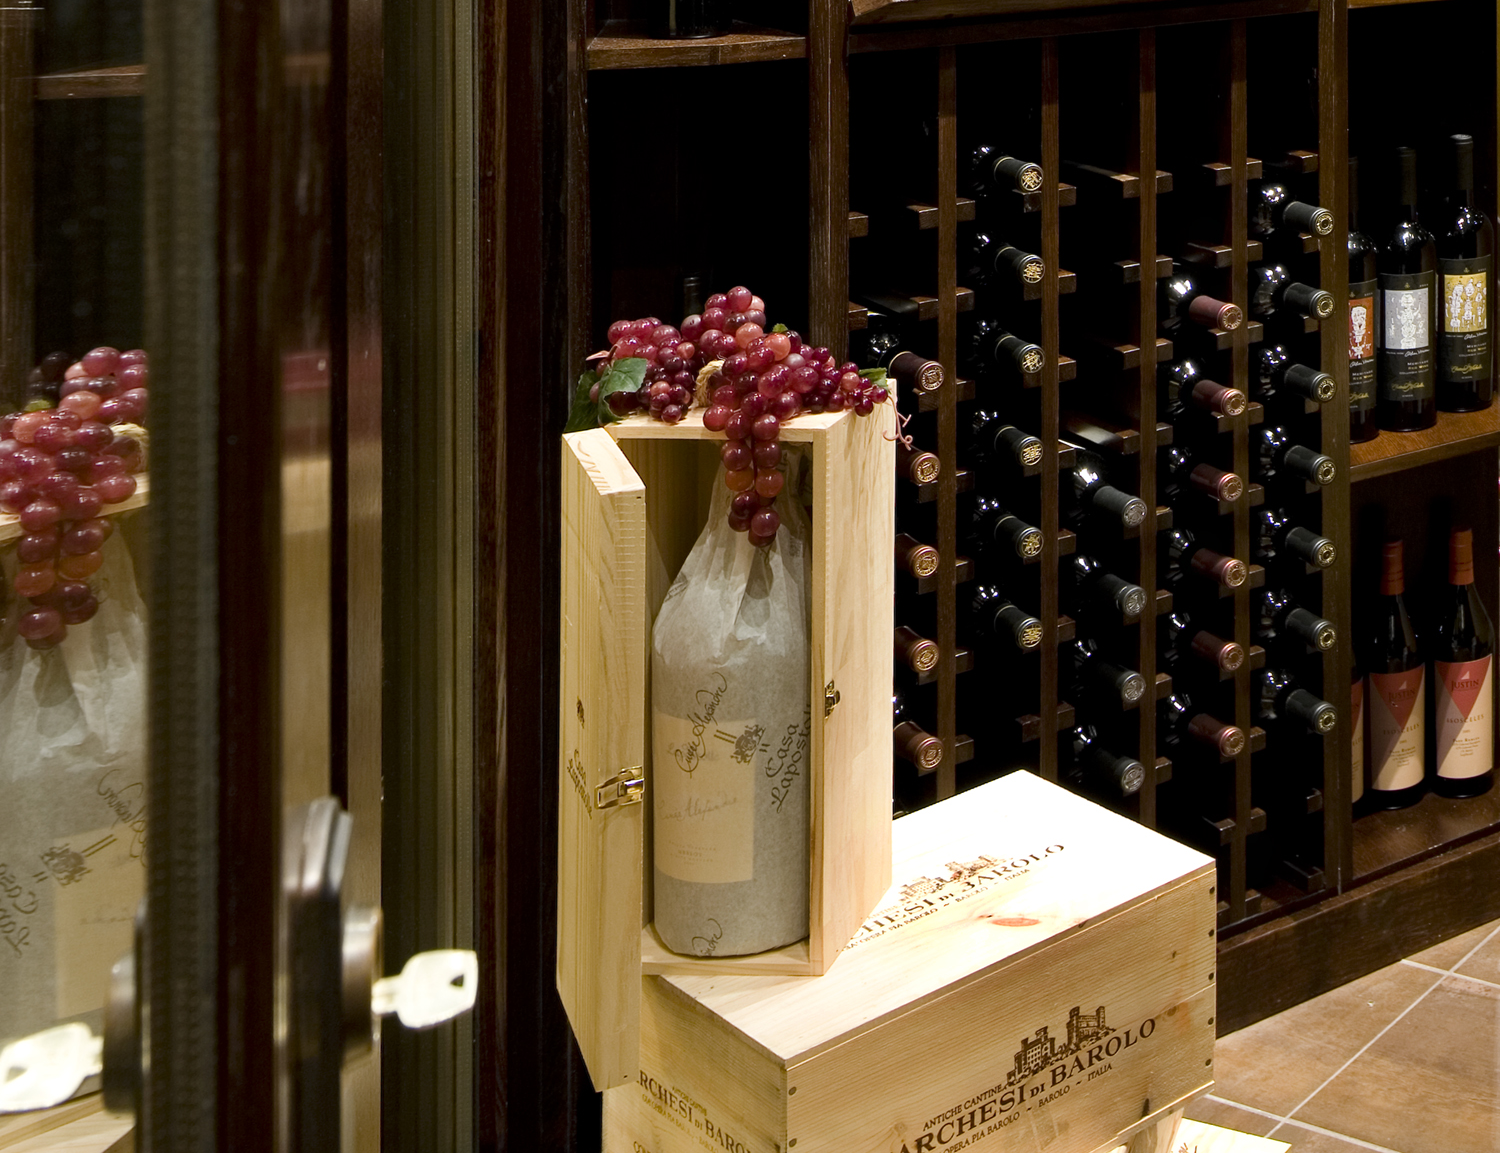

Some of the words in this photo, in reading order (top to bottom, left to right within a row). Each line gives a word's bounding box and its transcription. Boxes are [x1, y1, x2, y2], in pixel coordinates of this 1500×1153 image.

[1388, 689, 1415, 702] JUSTIN
[1451, 678, 1479, 693] JUSTIN
[1383, 722, 1420, 735] ISOSCELES
[1446, 714, 1485, 724] ISOSCELES
[765, 723, 799, 778] Casa
[961, 843, 1065, 892] BAROLO
[1029, 1081, 1045, 1098] DI
[1050, 1018, 1156, 1088] BAROLO
[923, 1100, 963, 1131] ANTICHE
[963, 1083, 1003, 1110] CANTINE
[971, 1129, 986, 1144] PIA
[986, 1111, 1020, 1137] BAROLO
[1038, 1084, 1070, 1108] BAROLO
[1086, 1062, 1113, 1082] ITALIA
